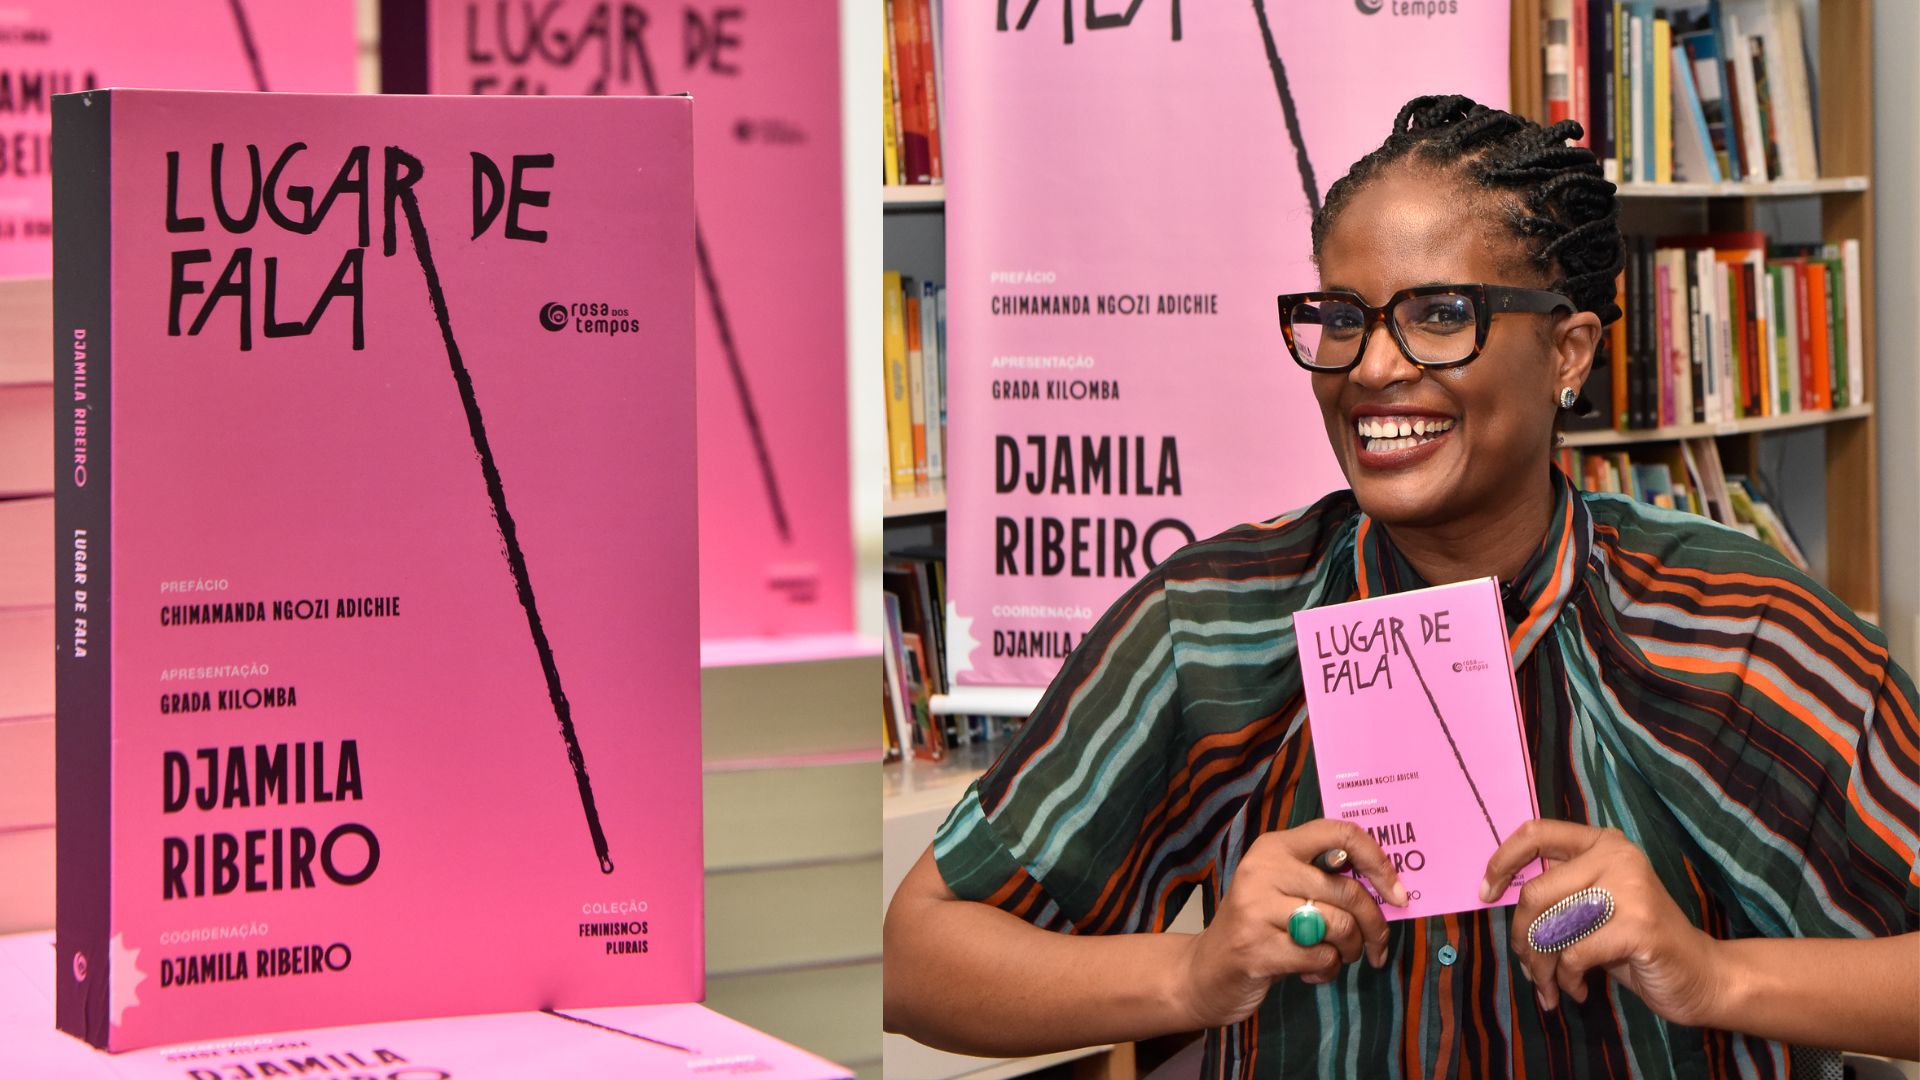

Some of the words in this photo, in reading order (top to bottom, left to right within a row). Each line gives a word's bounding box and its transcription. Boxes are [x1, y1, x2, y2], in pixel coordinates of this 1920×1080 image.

[1392, 0, 1458, 18] tempos
[165, 141, 425, 257] LUGAR
[470, 151, 555, 243] DE
[990, 271, 1056, 283] PREFÁCIO
[167, 247, 365, 351] FALA
[571, 303, 609, 317] rosa
[611, 309, 629, 317] DOS
[991, 295, 1090, 315] CHIMAMANDA
[1097, 295, 1150, 314] NGOZI
[1157, 294, 1218, 314] ADICHIE
[576, 317, 640, 337] tempos
[74, 329, 87, 401] DJAMILA
[991, 355, 1094, 370] APRESENTAÇÃO
[992, 380, 1040, 400] GRADA
[1046, 380, 1120, 400] KILOMBA
[74, 408, 87, 488] RIBEIRO
[995, 435, 1182, 496] DJAMILA
[74, 529, 87, 585] LUGAR
[995, 517, 1197, 578] RIBEIRO
[160, 579, 229, 593] PREFÁCIO
[74, 590, 87, 613] DE
[160, 600, 265, 627] CHIMAMANDA
[273, 599, 329, 621] NGOZI
[336, 596, 401, 619] ADICHIE
[992, 605, 1092, 620] COORDENAÇÃO
[74, 618, 87, 658] FALA
[993, 629, 1072, 658] DJAMILA
[1315, 616, 1404, 659] LUGAR
[1419, 610, 1451, 645] DE
[160, 663, 270, 682] APRESENTAÇÃO
[1322, 654, 1393, 695] FALA
[160, 691, 211, 715] GRADA
[218, 686, 298, 710] KILOMBA
[162, 739, 363, 813] DJAMILA
[1337, 777, 1373, 790] CHIMAMANDA
[1375, 774, 1396, 785] NGOZI
[1397, 771, 1419, 782] ADICHIE
[1341, 809, 1360, 819] GRADA
[1361, 805, 1389, 816] KILOMBA
[1367, 822, 1416, 847] AMILA
[162, 823, 380, 901] RIBEIRO
[582, 900, 648, 915] COLEÇÃO
[160, 923, 269, 945] COORDENAÇÃO
[579, 921, 648, 937] FEMINISMOS
[606, 940, 648, 954] PLURAIS
[160, 951, 249, 989] DJAMILA
[256, 942, 352, 979] RIBEIRO
